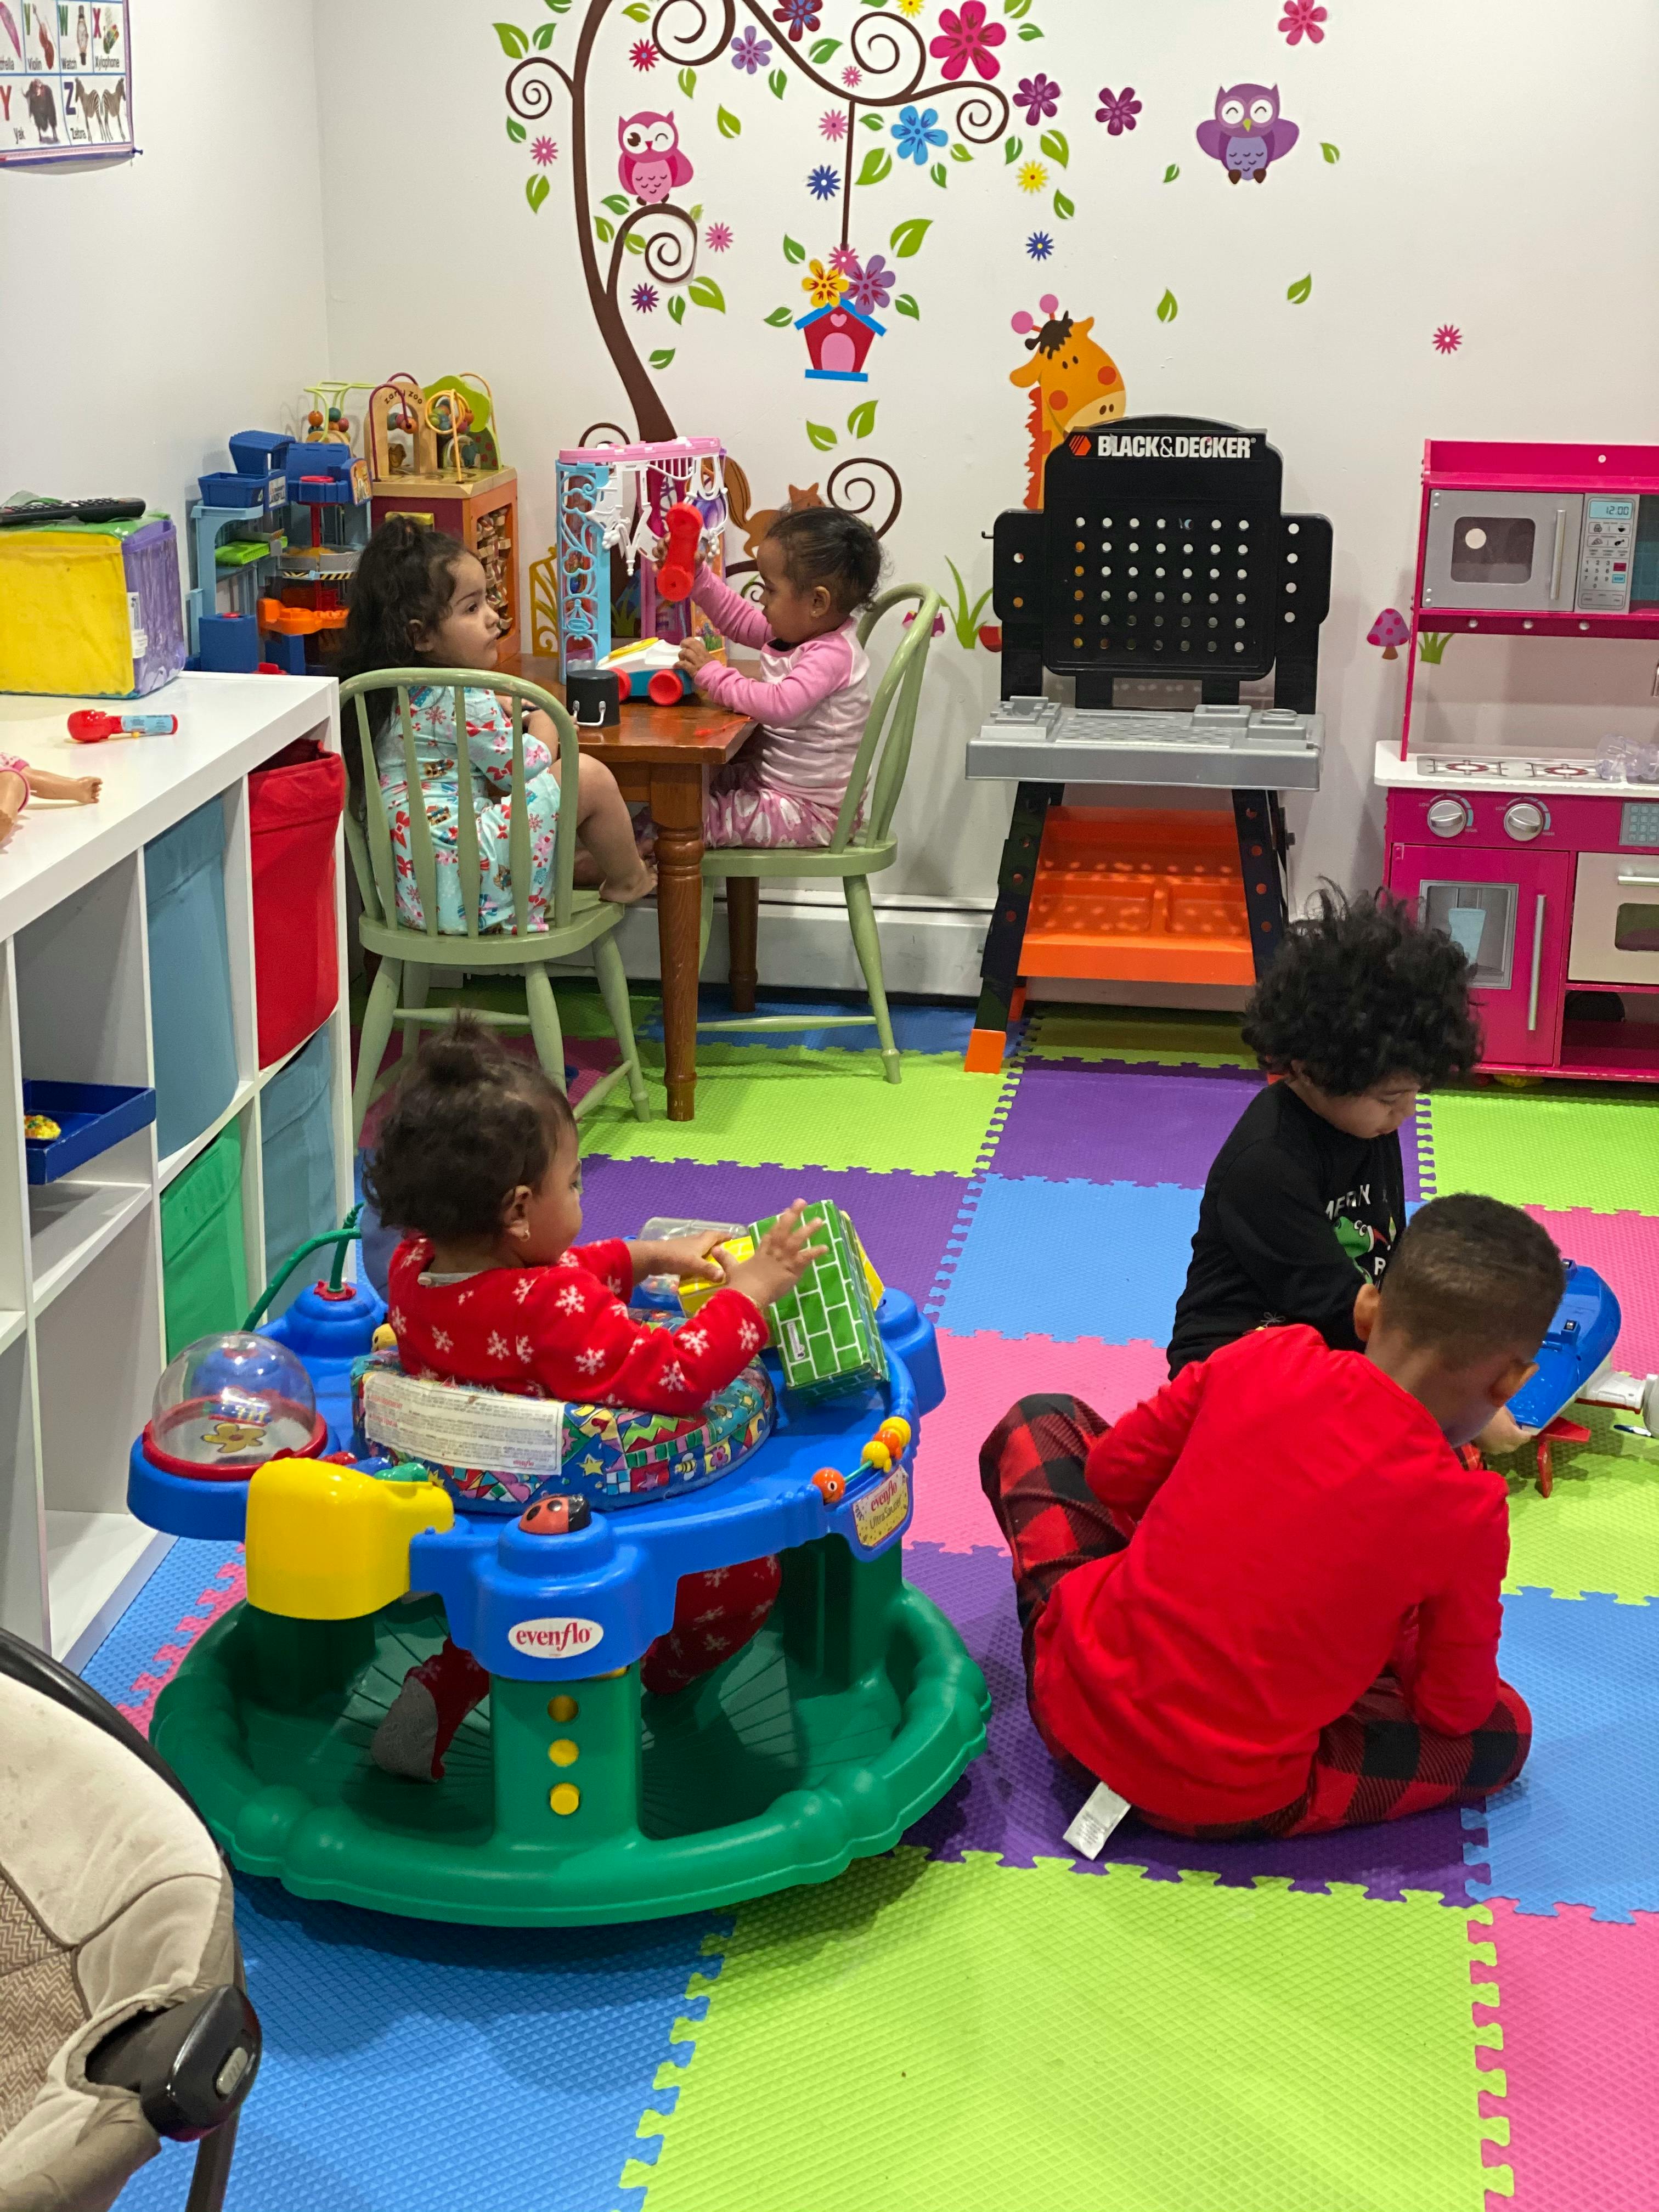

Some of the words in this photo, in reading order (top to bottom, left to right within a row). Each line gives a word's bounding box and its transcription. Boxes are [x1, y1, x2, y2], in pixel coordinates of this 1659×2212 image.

[23, 3, 31, 36] V
[58, 5, 69, 36] W
[93, 8, 101, 38] X
[0, 85, 12, 121] Y
[64, 82, 76, 115] Z
[14, 127, 25, 144] Yak
[408, 391, 422, 404] zoo
[1098, 435, 1251, 459] BLACK&DECKER
[1606, 505, 1629, 516] 12:00
[871, 1480, 897, 1512] evenflo
[516, 1622, 590, 1652] evenflo
